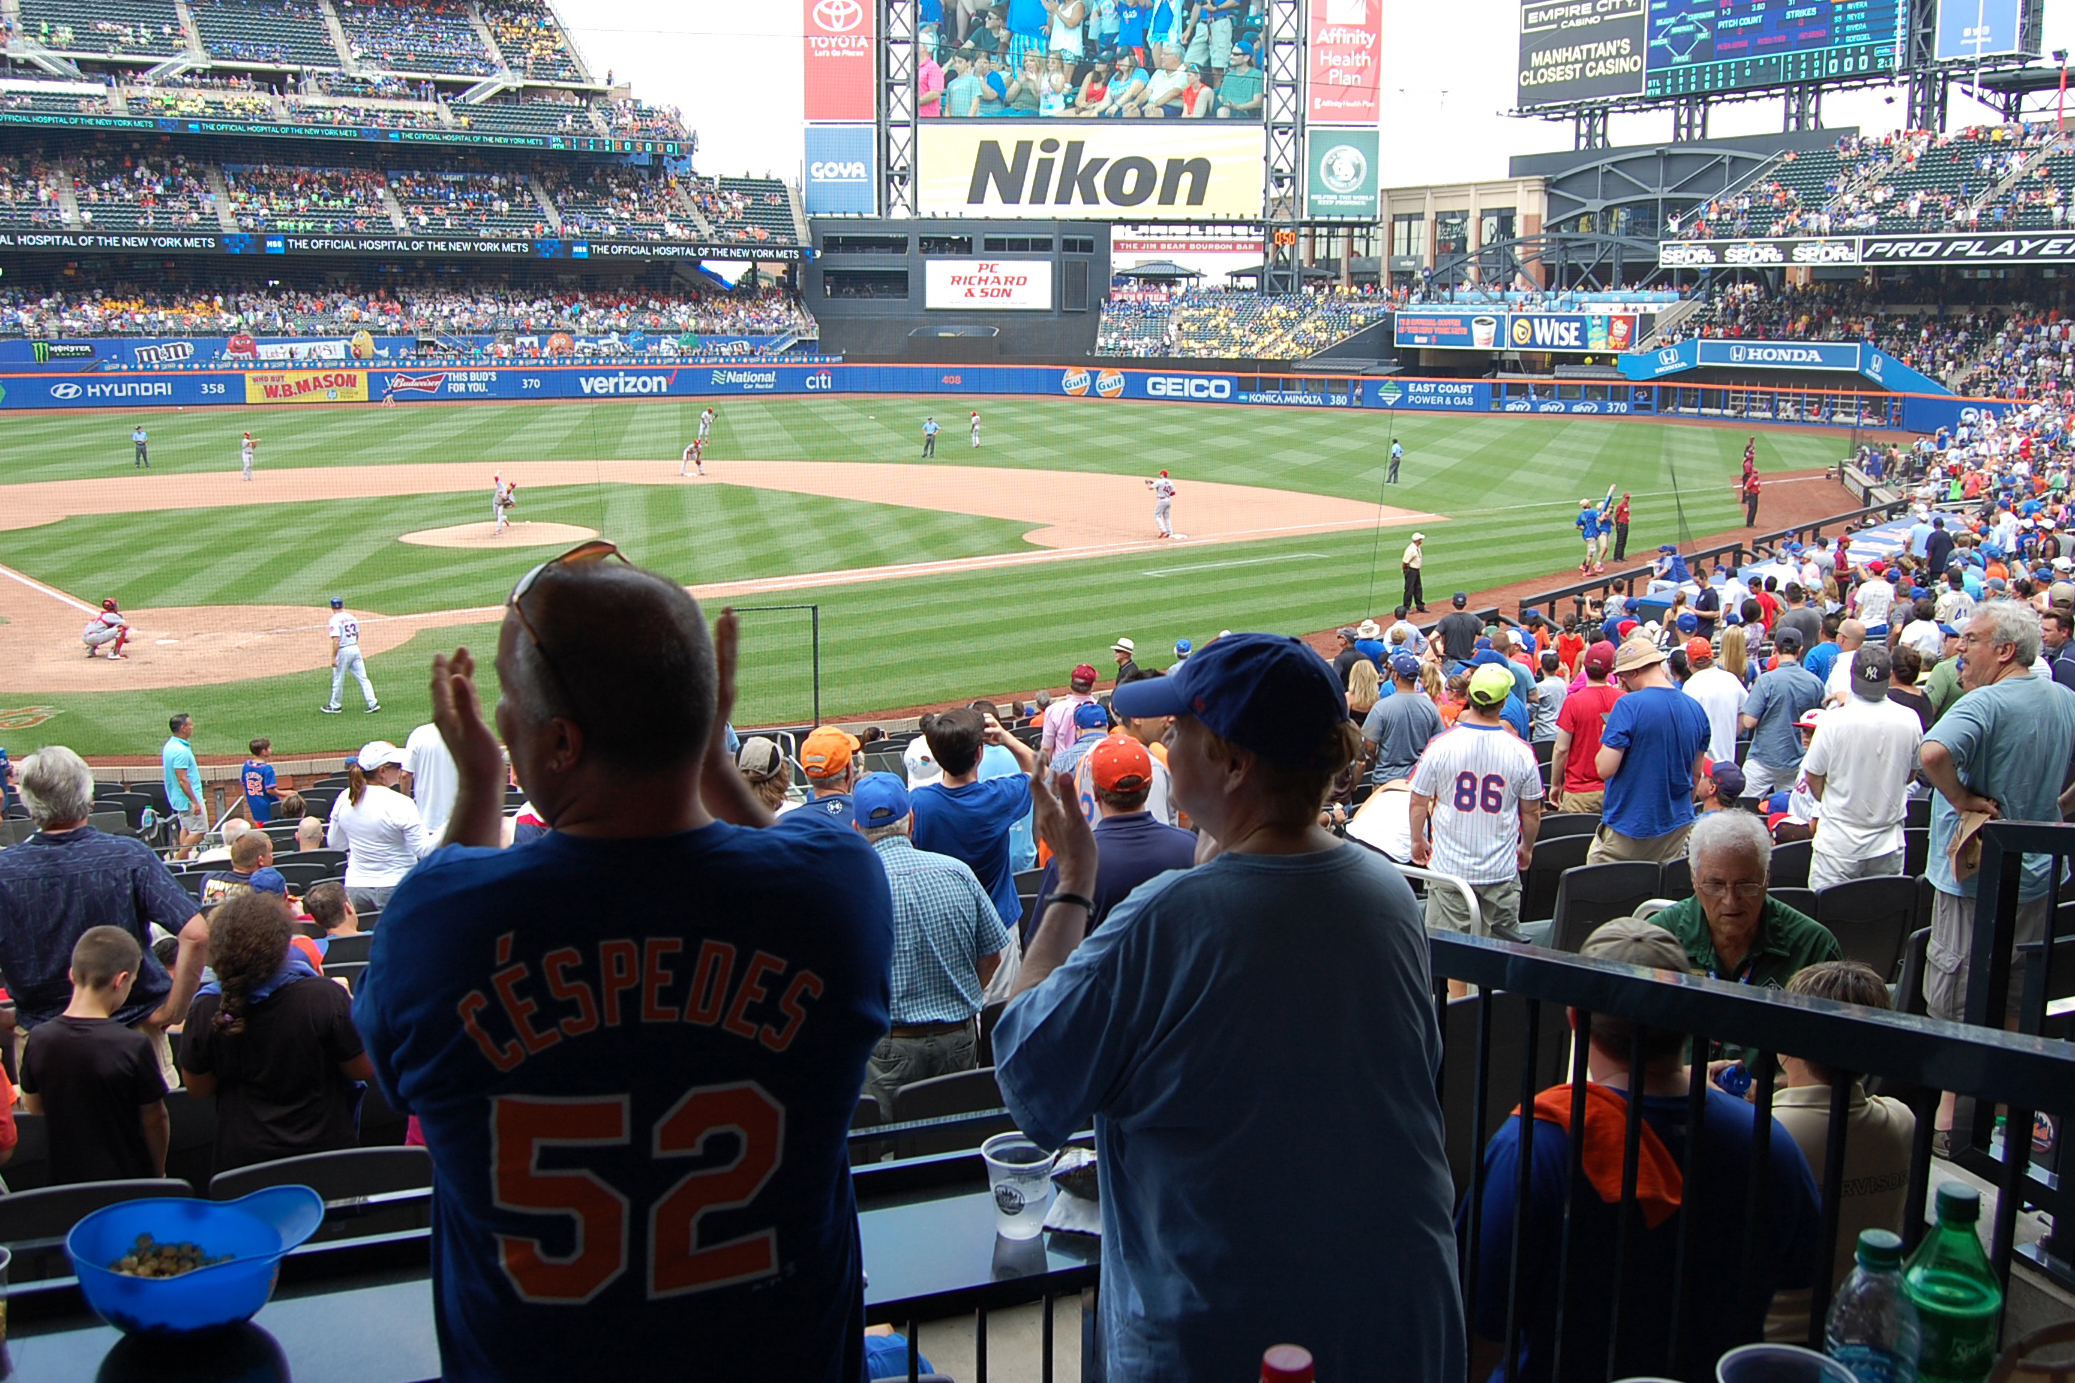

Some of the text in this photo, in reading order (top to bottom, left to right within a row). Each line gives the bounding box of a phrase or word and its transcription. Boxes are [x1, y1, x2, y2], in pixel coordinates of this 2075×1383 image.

[1528, 3, 1592, 24] EMPIRE
[1785, 7, 1817, 20] STRIKES
[1560, 15, 1601, 29] CASINO
[1717, 15, 1763, 30] PITCH COUNT
[808, 35, 869, 48] TOYOTA
[1315, 27, 1377, 49] Affinity
[1320, 49, 1371, 67] Health
[1531, 38, 1631, 68] MANHATTAN'S
[1520, 55, 1642, 87] CLOSEST CASINO
[1829, 55, 1868, 74] 0 0 0
[1329, 68, 1361, 86] Plan
[1647, 79, 1661, 88] STL
[32, 115, 69, 125] HOSPITAL
[69, 117, 79, 125] OF
[80, 117, 94, 125] THE
[95, 118, 112, 126] NEW
[113, 119, 133, 127] YORK
[134, 120, 153, 128] METS
[201, 123, 215, 131] THE
[216, 124, 246, 132] OFFICIAL
[247, 125, 279, 134] HOSPITAL
[290, 127, 303, 135] THE
[304, 128, 319, 136] NEW
[320, 129, 338, 137] YORK
[339, 130, 357, 138] METS
[401, 132, 413, 140] THE
[414, 133, 441, 141] OFFICIAL
[442, 134, 472, 142] HOSPITAL
[482, 135, 493, 143] THE
[494, 136, 508, 144] NEW
[810, 161, 866, 179] GOYA
[966, 138, 1213, 207] Nikon
[17, 235, 77, 246] HOSPITAL
[78, 236, 95, 246] OF
[96, 236, 120, 246] THE
[121, 236, 149, 247] NEW
[150, 237, 182, 248] YORK
[184, 238, 216, 248] METS
[287, 239, 529, 253] THE OFFICIAL HOSPITAL OF THE NEW YORK METS
[1120, 242, 1138, 250] THE
[1189, 243, 1233, 251] BOURBON
[1236, 243, 1255, 251] BAR
[590, 245, 799, 259] THE OFFICIAL HOSPITAL OF THE NEW YORK METS
[1863, 241, 1943, 258] PRO
[950, 275, 1028, 286] RICHARD
[964, 287, 1013, 298] & SON
[1533, 318, 1582, 346] WISE
[49, 344, 92, 353] MONSTER
[1747, 348, 1823, 362] HONDA
[1654, 361, 1688, 374] HONDA
[392, 377, 441, 388] Budweiser
[448, 371, 497, 382] THIS BUD'S
[521, 378, 541, 389] 370
[580, 372, 667, 394] verizon
[726, 370, 776, 384] National
[805, 373, 832, 389] citi
[941, 375, 962, 385] 408
[87, 383, 172, 397] HYUNDAI
[200, 383, 225, 394] 358
[448, 382, 488, 392] FOR YOU.
[1065, 377, 1123, 392] Gulf Gulf
[1147, 377, 1231, 399] GEICO
[1408, 383, 1474, 394] EAST COAST
[1249, 393, 1323, 405] KONICA MINOLTA
[1330, 395, 1348, 406] 380
[1408, 395, 1474, 406] POWER & GAS
[1505, 401, 1597, 414] SNY SNY SNY
[1606, 402, 1628, 413] 370
[1954, 608, 1968, 621] 41
[1864, 665, 1878, 680] NY
[246, 779, 263, 796] 52
[1453, 771, 1505, 814] 86
[457, 930, 824, 1072] CÉSPEDES
[487, 1080, 786, 1305] 52
